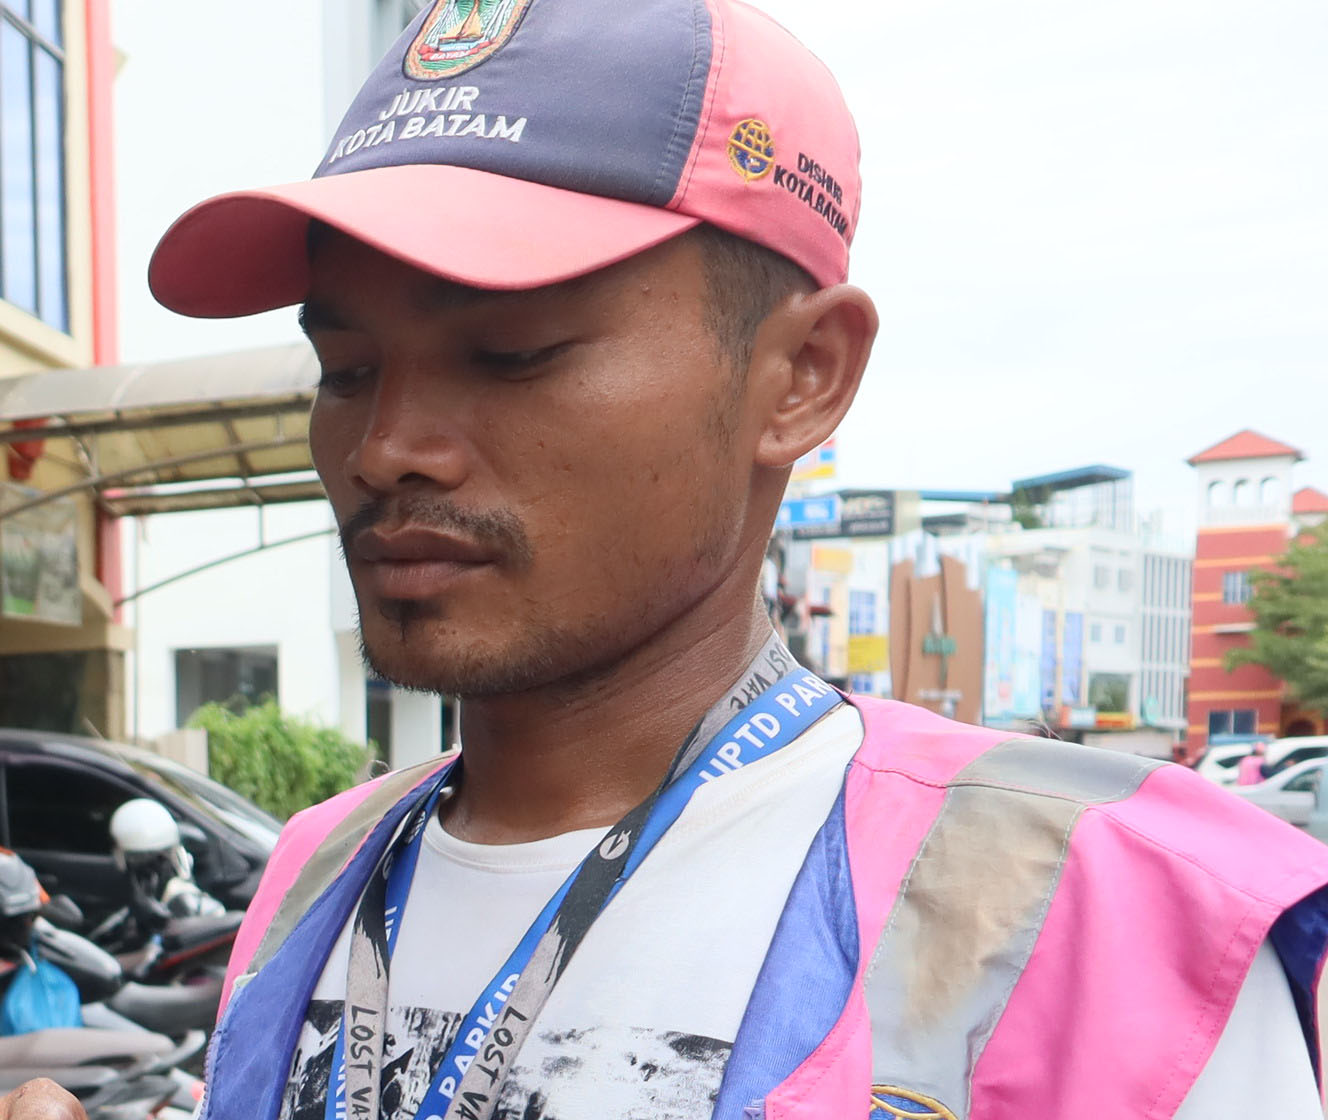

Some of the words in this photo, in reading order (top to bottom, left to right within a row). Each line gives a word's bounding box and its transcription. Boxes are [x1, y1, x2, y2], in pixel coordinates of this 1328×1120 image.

[378, 86, 480, 121] JUKIR
[328, 120, 396, 163] KOTA
[398, 114, 528, 143] BATAM
[773, 164, 814, 208] KOTA
[349, 1004, 378, 1079] LOST
[475, 1005, 529, 1088] LOST
